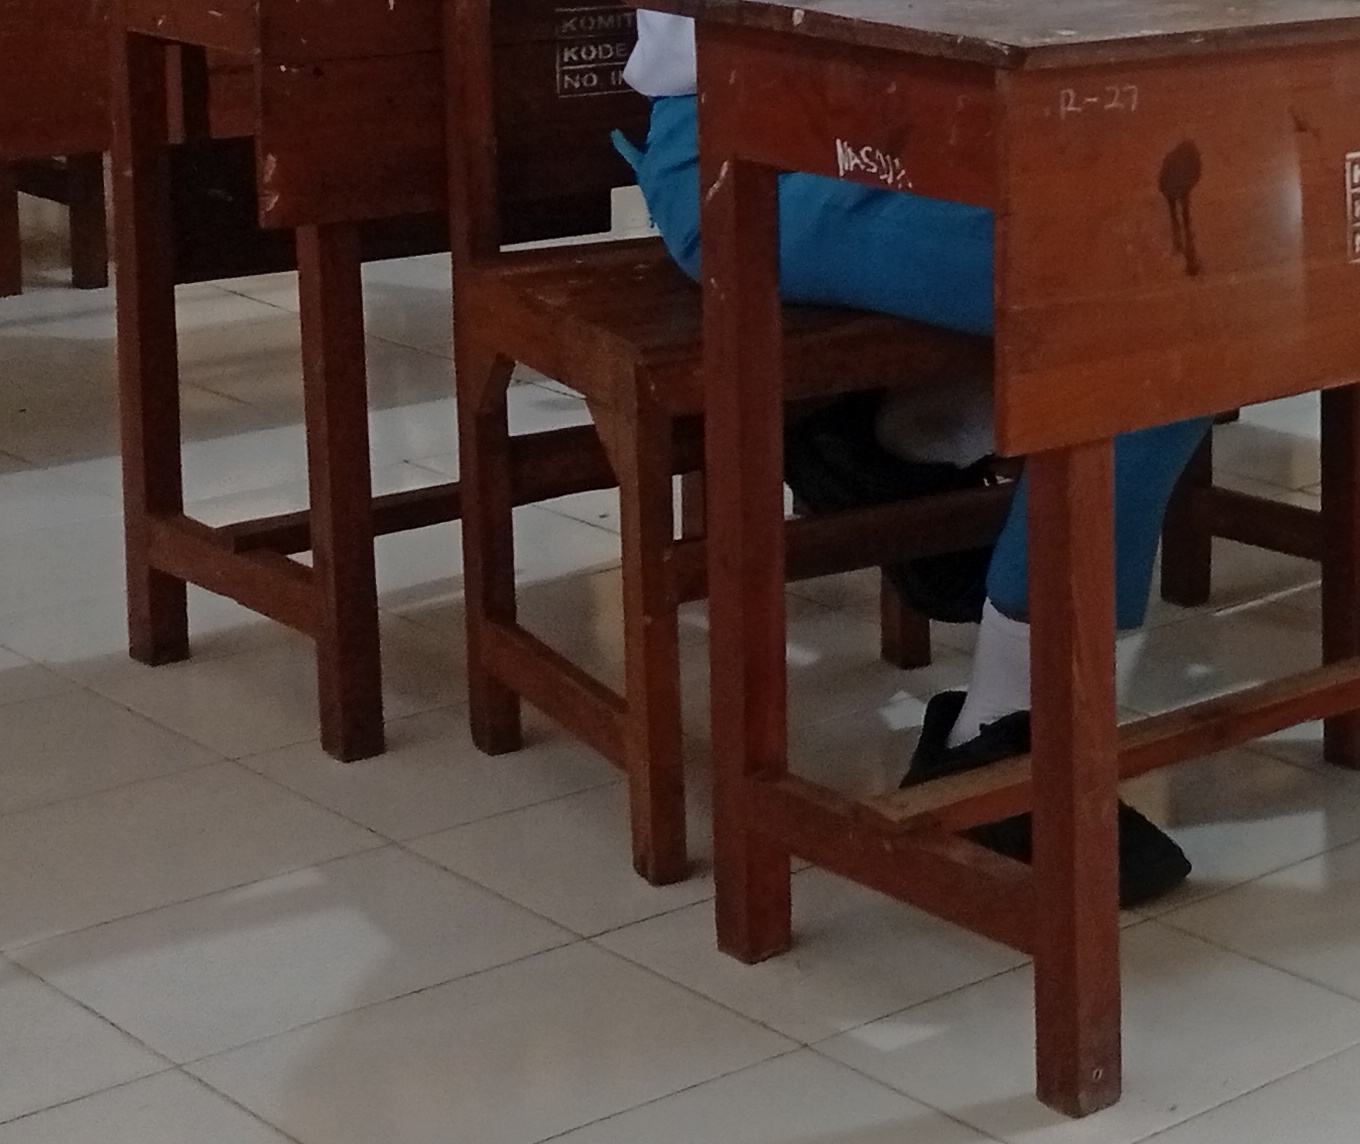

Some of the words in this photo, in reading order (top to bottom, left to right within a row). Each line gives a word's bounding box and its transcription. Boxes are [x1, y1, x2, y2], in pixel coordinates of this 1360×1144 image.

[562, 12, 636, 33] KOMIT
[563, 43, 629, 63] KODE
[1059, 85, 1139, 120] R-27
